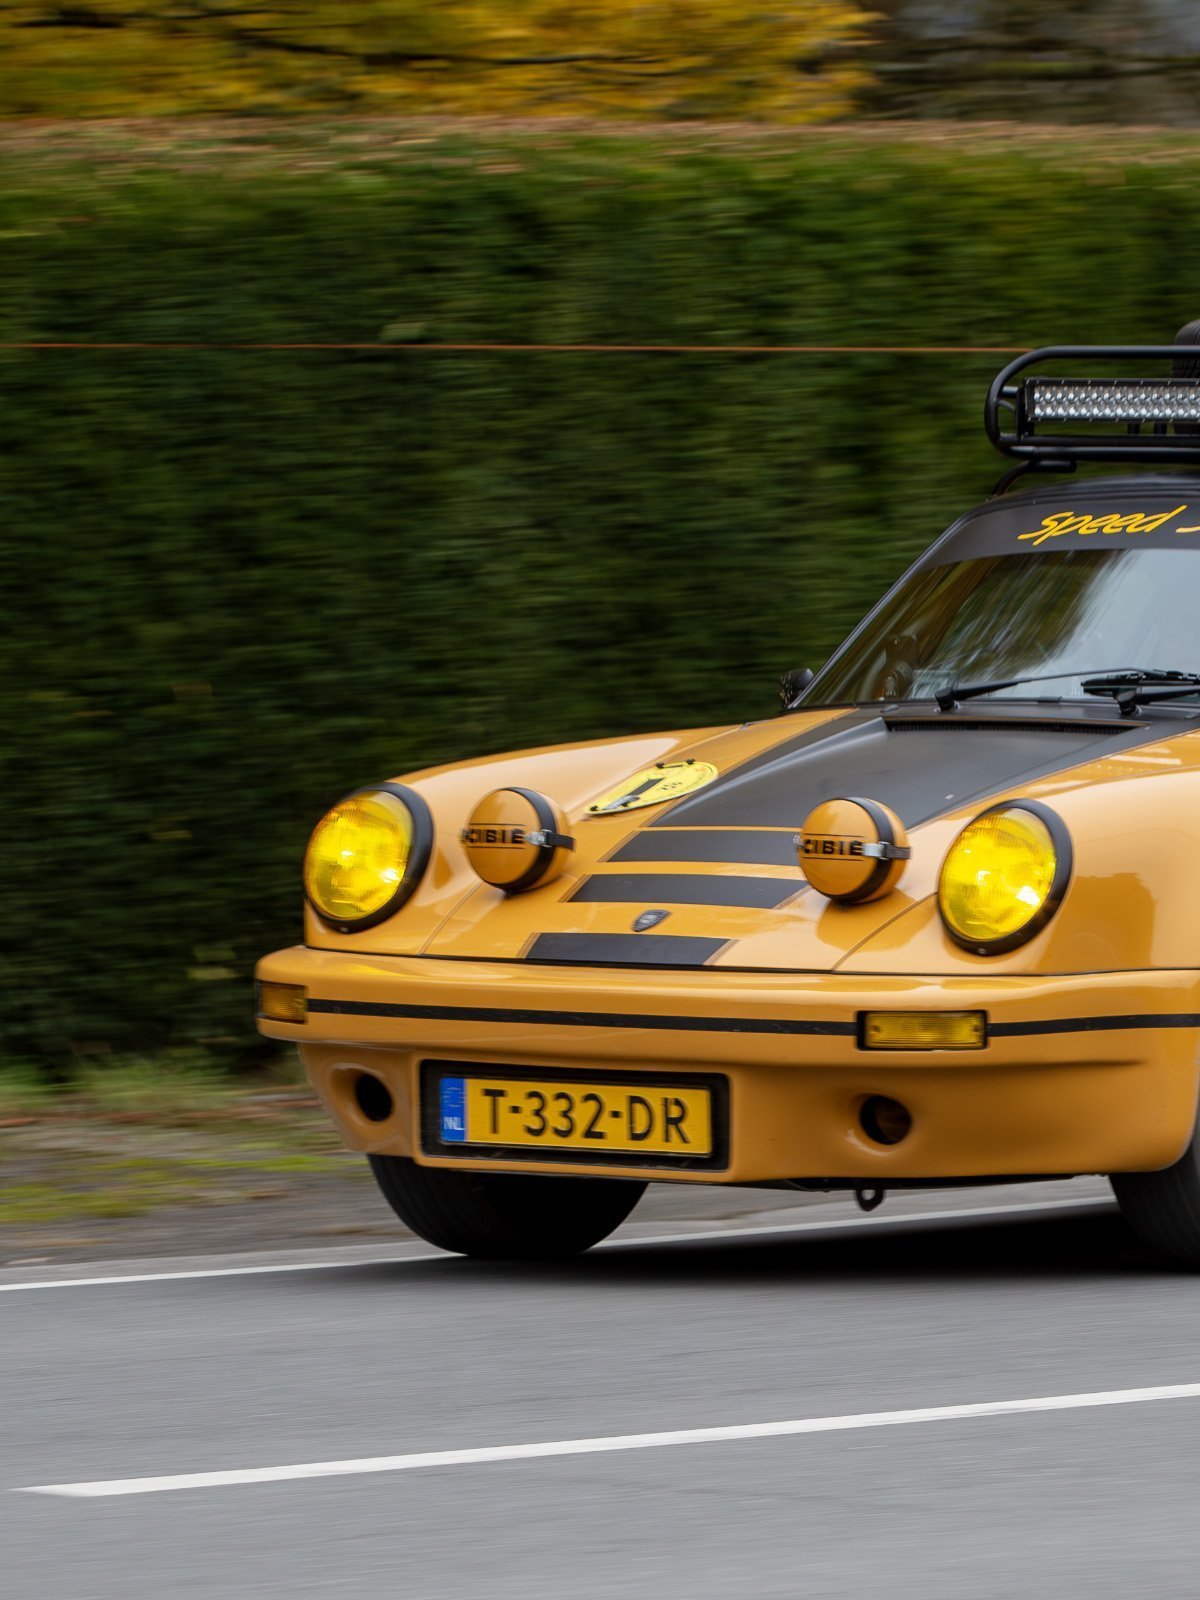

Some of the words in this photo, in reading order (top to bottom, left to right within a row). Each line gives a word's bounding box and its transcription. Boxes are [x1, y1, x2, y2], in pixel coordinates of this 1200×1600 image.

[1017, 504, 1188, 546] Speed
[443, 1116, 465, 1131] NL
[481, 1087, 691, 1144] T-332-DR
